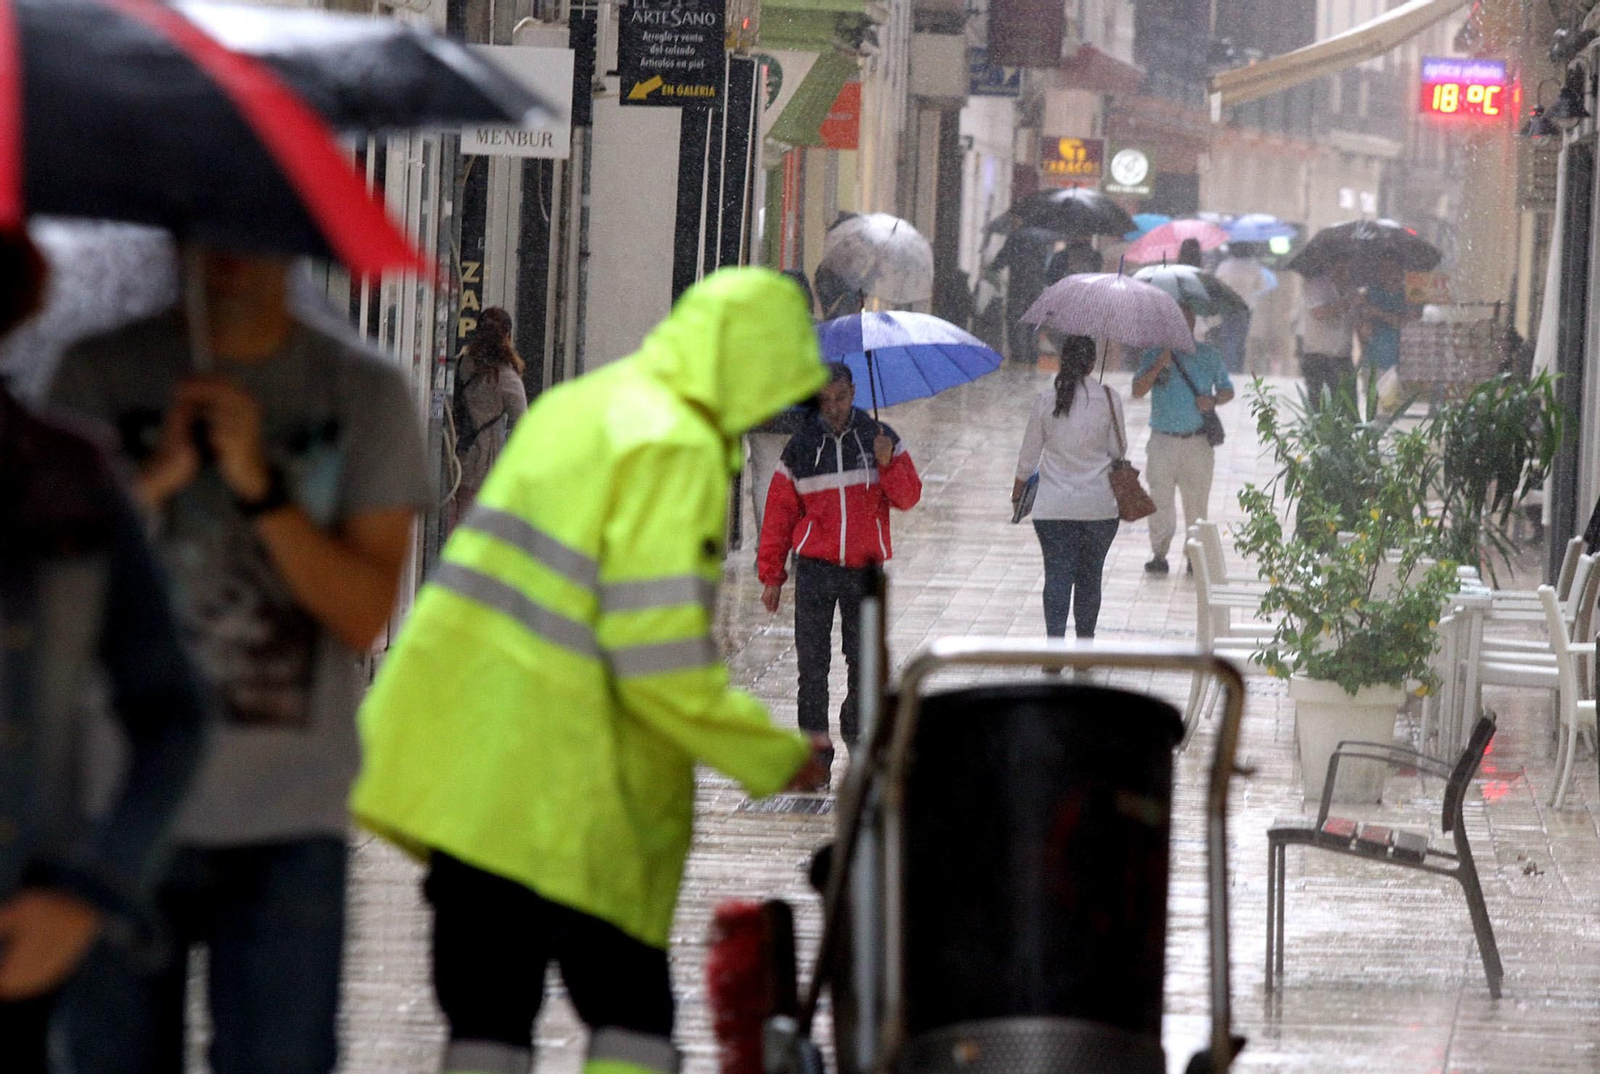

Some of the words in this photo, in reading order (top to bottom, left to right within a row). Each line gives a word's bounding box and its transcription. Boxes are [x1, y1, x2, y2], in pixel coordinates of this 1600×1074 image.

[631, 8, 716, 27] ARTESANO
[642, 30, 673, 44] Arreglo
[681, 33, 704, 43] venta
[650, 44, 663, 55] del
[665, 44, 696, 55] calzado
[676, 60, 687, 69] en
[688, 58, 705, 71] piel
[661, 84, 675, 96] EN
[1432, 83, 1459, 113] 18
[476, 128, 553, 148] MENBUR
[457, 261, 481, 355] ZAP
